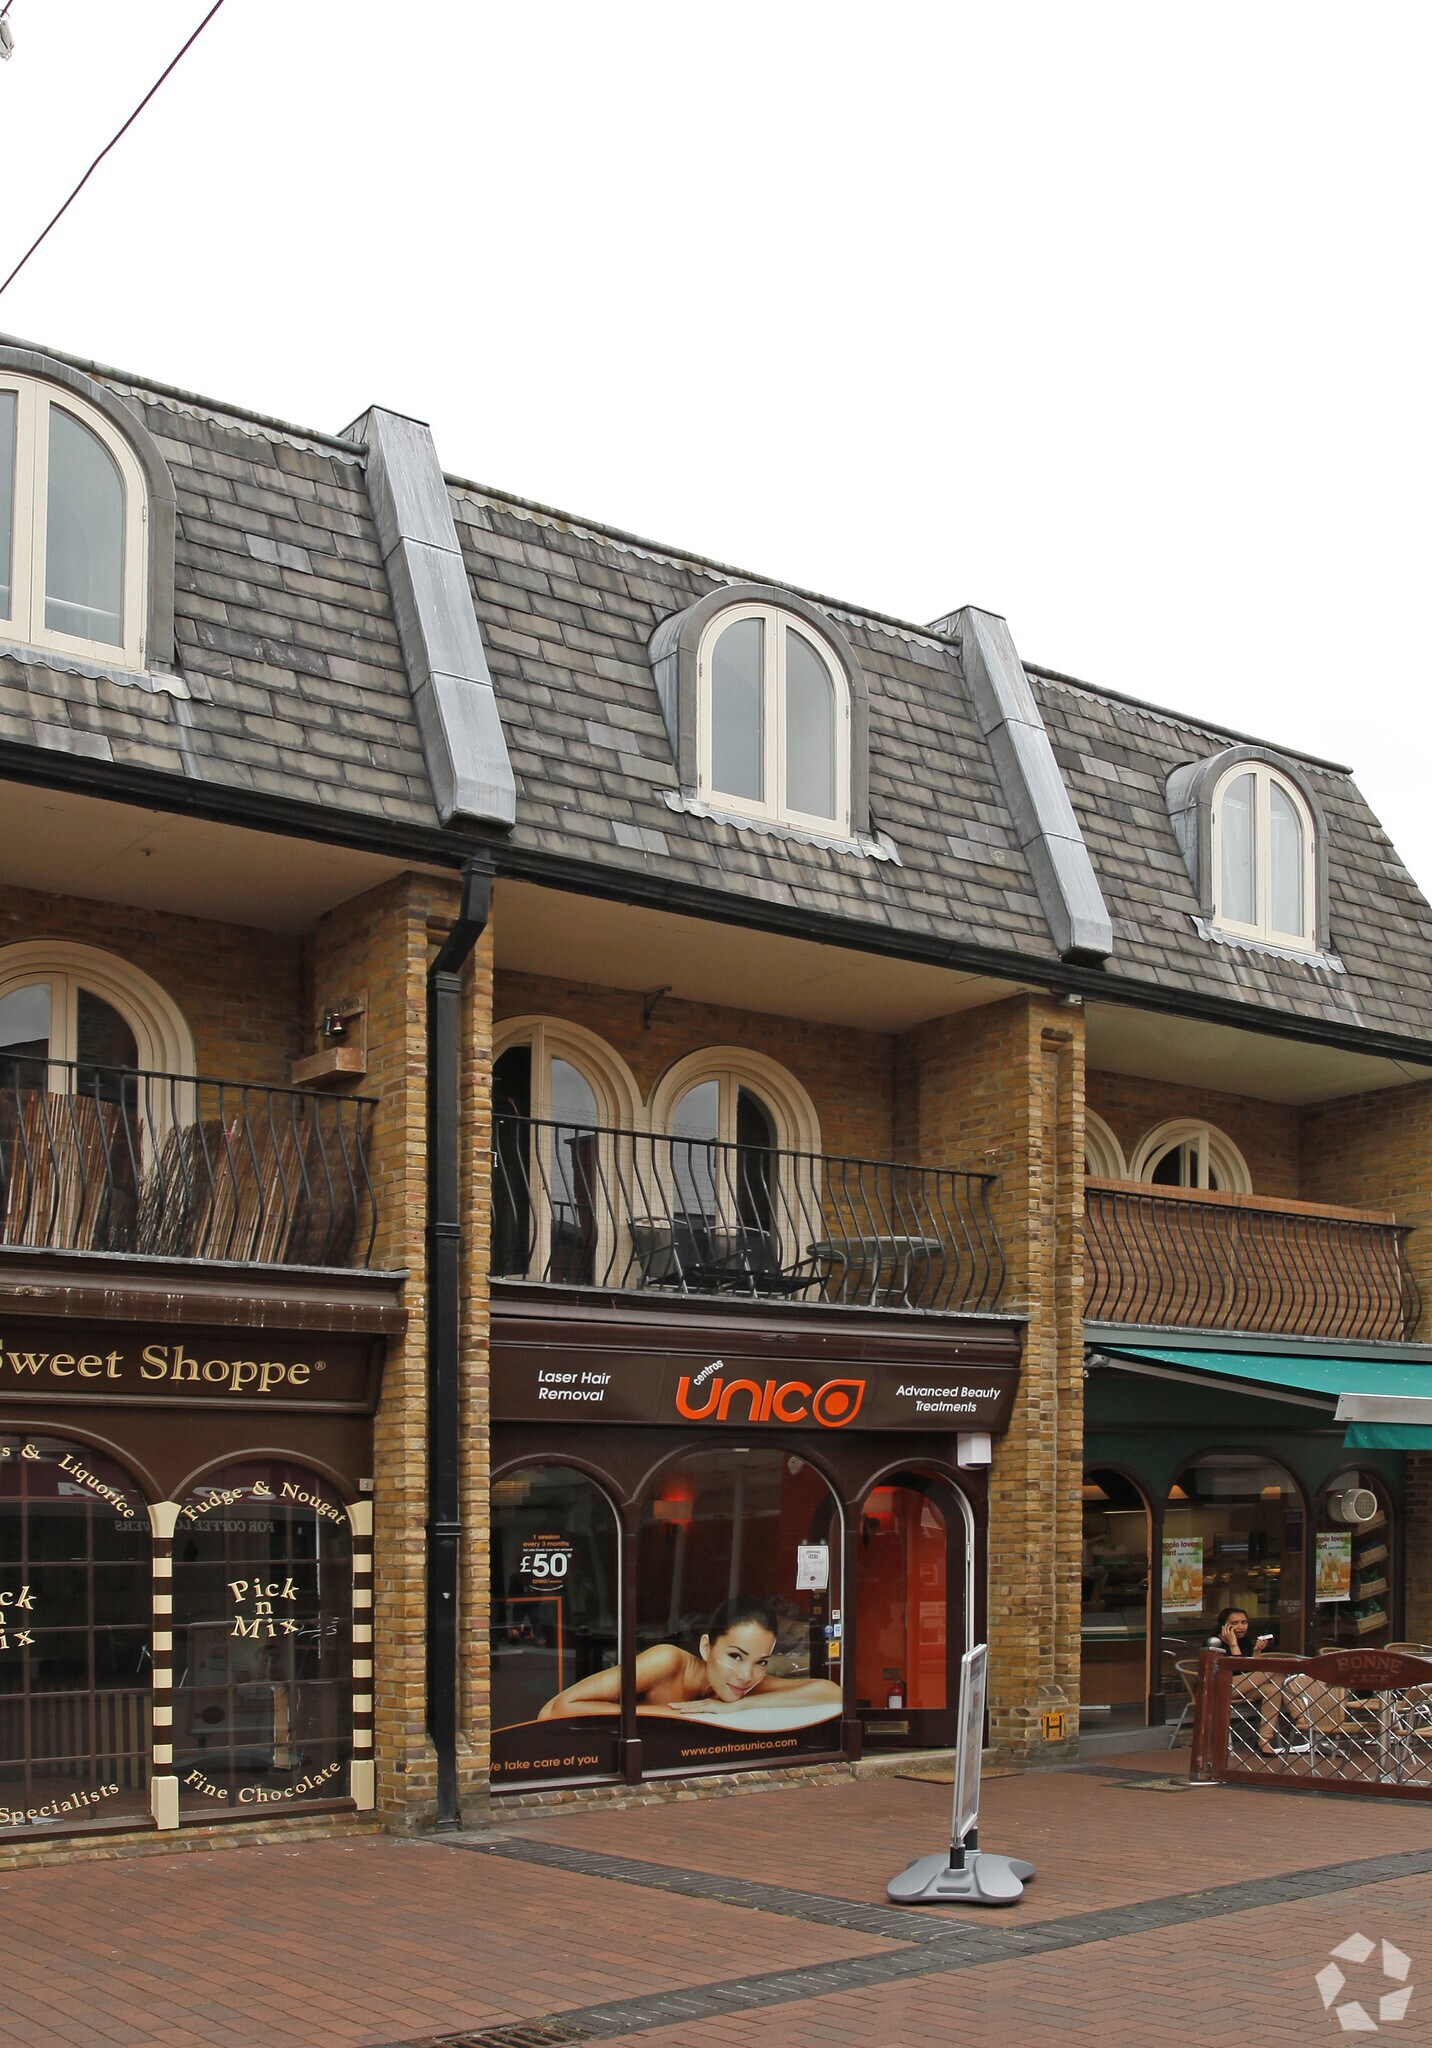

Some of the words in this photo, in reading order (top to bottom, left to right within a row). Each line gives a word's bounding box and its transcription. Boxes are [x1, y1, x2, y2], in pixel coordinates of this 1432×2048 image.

[0, 1339, 124, 1378] weet
[538, 1370, 577, 1384] Laser
[581, 1371, 611, 1385] Hair
[693, 1360, 724, 1386] centros
[538, 1387, 604, 1401] Removal
[896, 1385, 959, 1397] Advanced
[961, 1387, 1001, 1400] Beauty
[915, 1400, 978, 1412] Treatments
[21, 1443, 41, 1460] &
[58, 1453, 135, 1518] Liquorice
[181, 1488, 243, 1521] Fudge
[252, 1480, 272, 1496] &
[280, 1482, 346, 1525] Nougat
[228, 1578, 299, 1602] Pick
[255, 1601, 273, 1615] n
[231, 1615, 299, 1639] Mix
[1336, 1656, 1403, 1674] BONNE
[681, 1738, 797, 1756] www.centrosunico.com
[504, 1760, 530, 1770] take
[533, 1759, 560, 1769] care
[563, 1755, 575, 1766] of
[577, 1755, 598, 1767] you
[183, 1769, 229, 1800] Fine
[238, 1760, 341, 1803] Chocolate
[0, 1782, 119, 1824] Specialists
